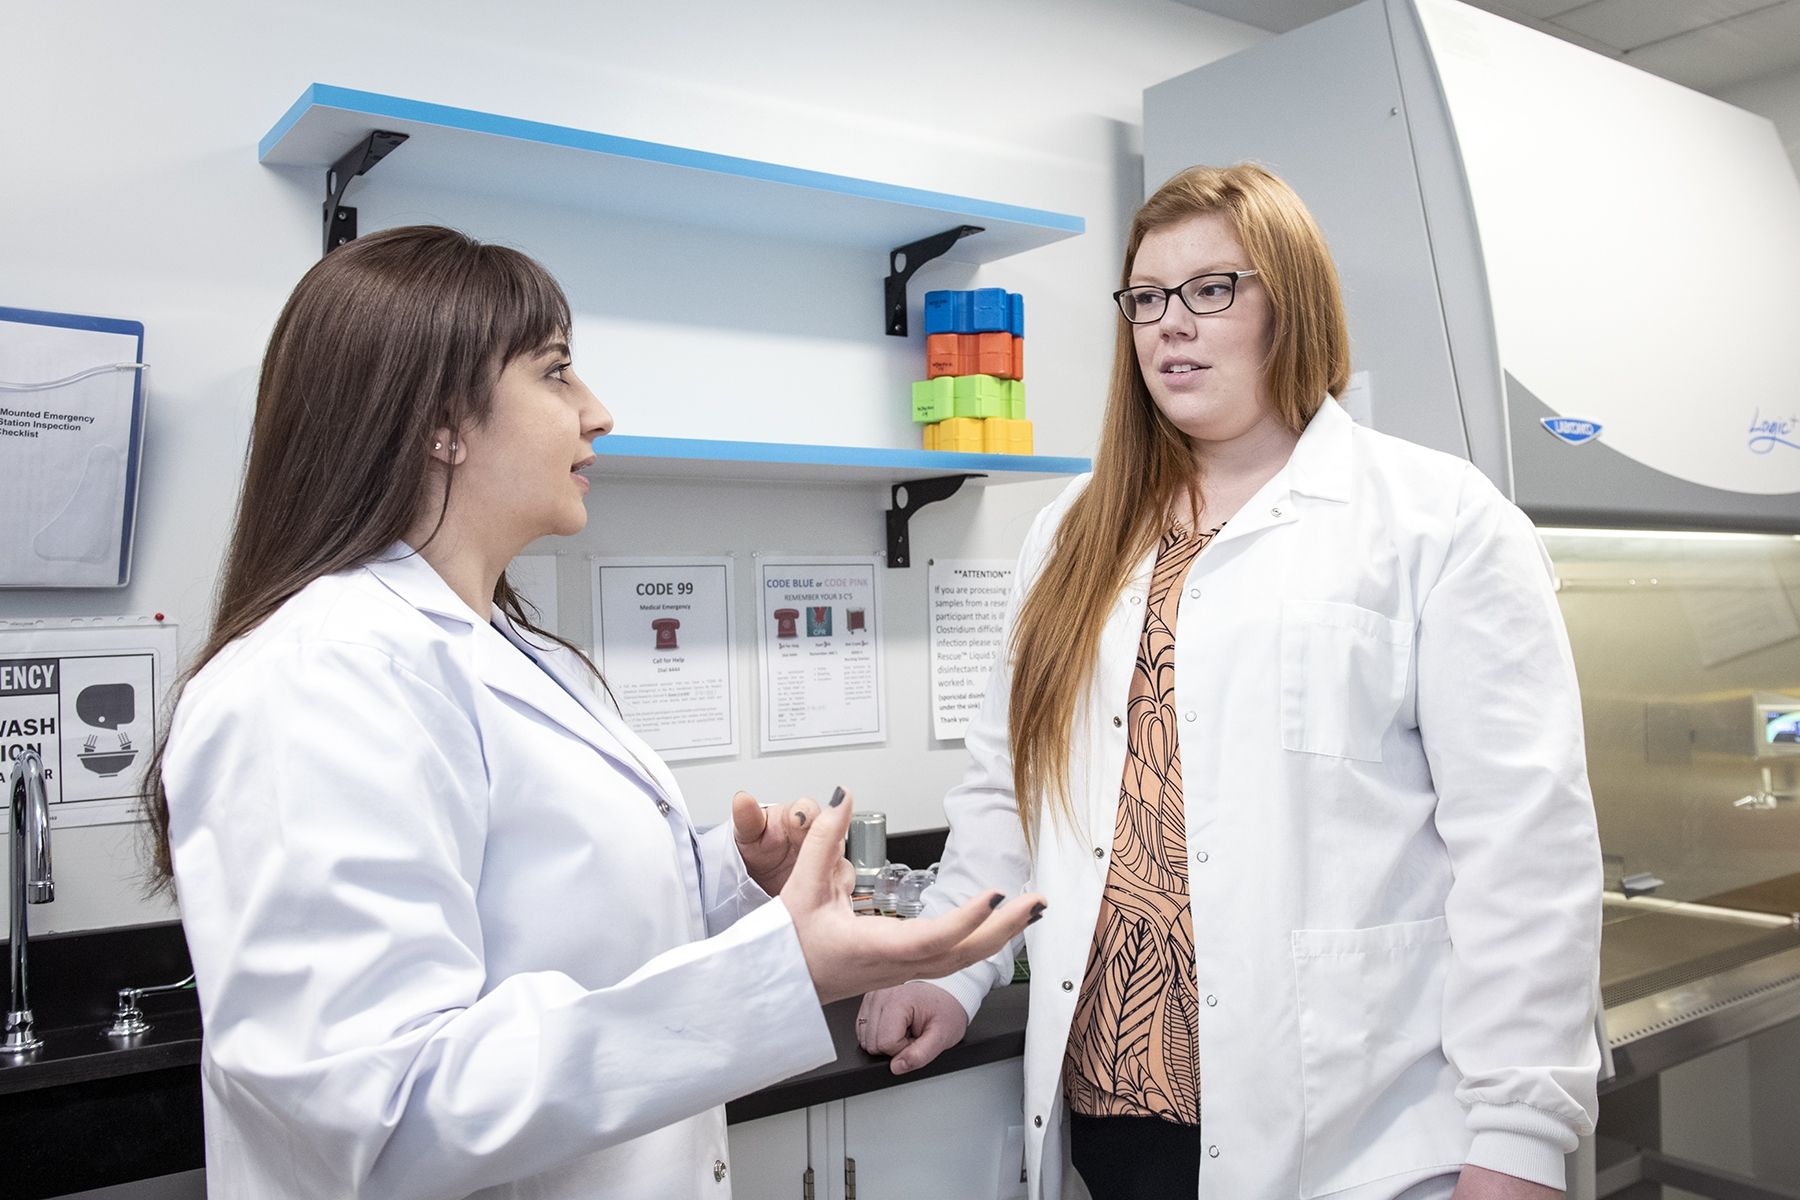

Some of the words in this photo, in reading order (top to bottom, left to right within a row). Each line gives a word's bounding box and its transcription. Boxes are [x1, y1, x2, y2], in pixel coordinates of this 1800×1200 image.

[0, 408, 41, 419] Mounted
[43, 411, 95, 424] Emergency
[0, 418, 31, 427] Station
[33, 421, 81, 431] Inspection
[766, 579, 790, 588] CODE
[793, 578, 814, 588] BLUE
[824, 578, 847, 588] CODE
[849, 578, 868, 587] PINK
[636, 583, 674, 596] CODE
[677, 582, 694, 595] 99
[941, 587, 954, 595] you
[970, 586, 1007, 596] processing
[784, 593, 819, 601] REMEMBER
[935, 599, 964, 608] samples
[965, 599, 982, 607] from
[936, 613, 973, 622] participant
[936, 626, 976, 634] Clostridium
[937, 639, 967, 647] infection
[968, 639, 991, 647] please
[969, 651, 991, 661] Liquid
[937, 665, 978, 674] disinfectant
[938, 678, 965, 687] worked
